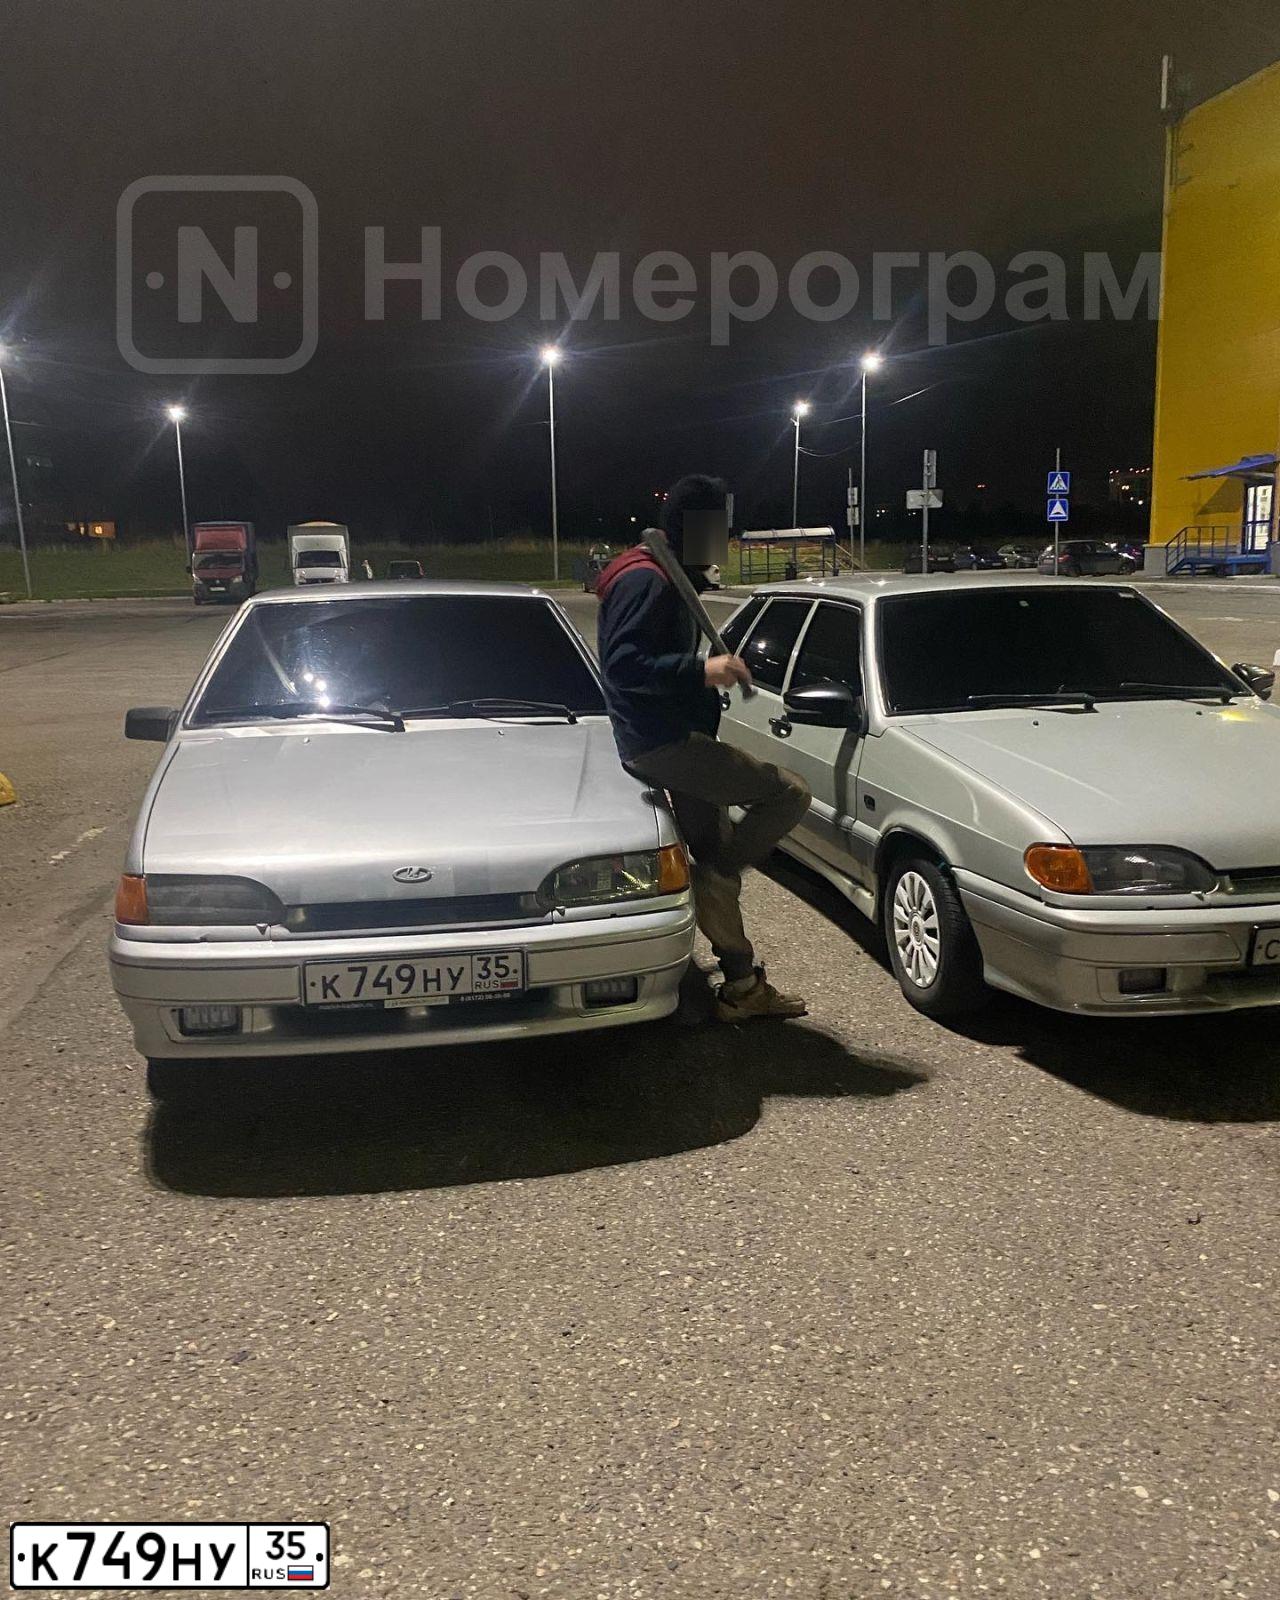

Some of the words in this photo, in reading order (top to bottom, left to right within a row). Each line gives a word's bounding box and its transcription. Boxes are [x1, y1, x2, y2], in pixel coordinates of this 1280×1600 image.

[321, 963, 465, 999] К749НУ
[476, 956, 510, 979] 35
[474, 980, 500, 990] RUS
